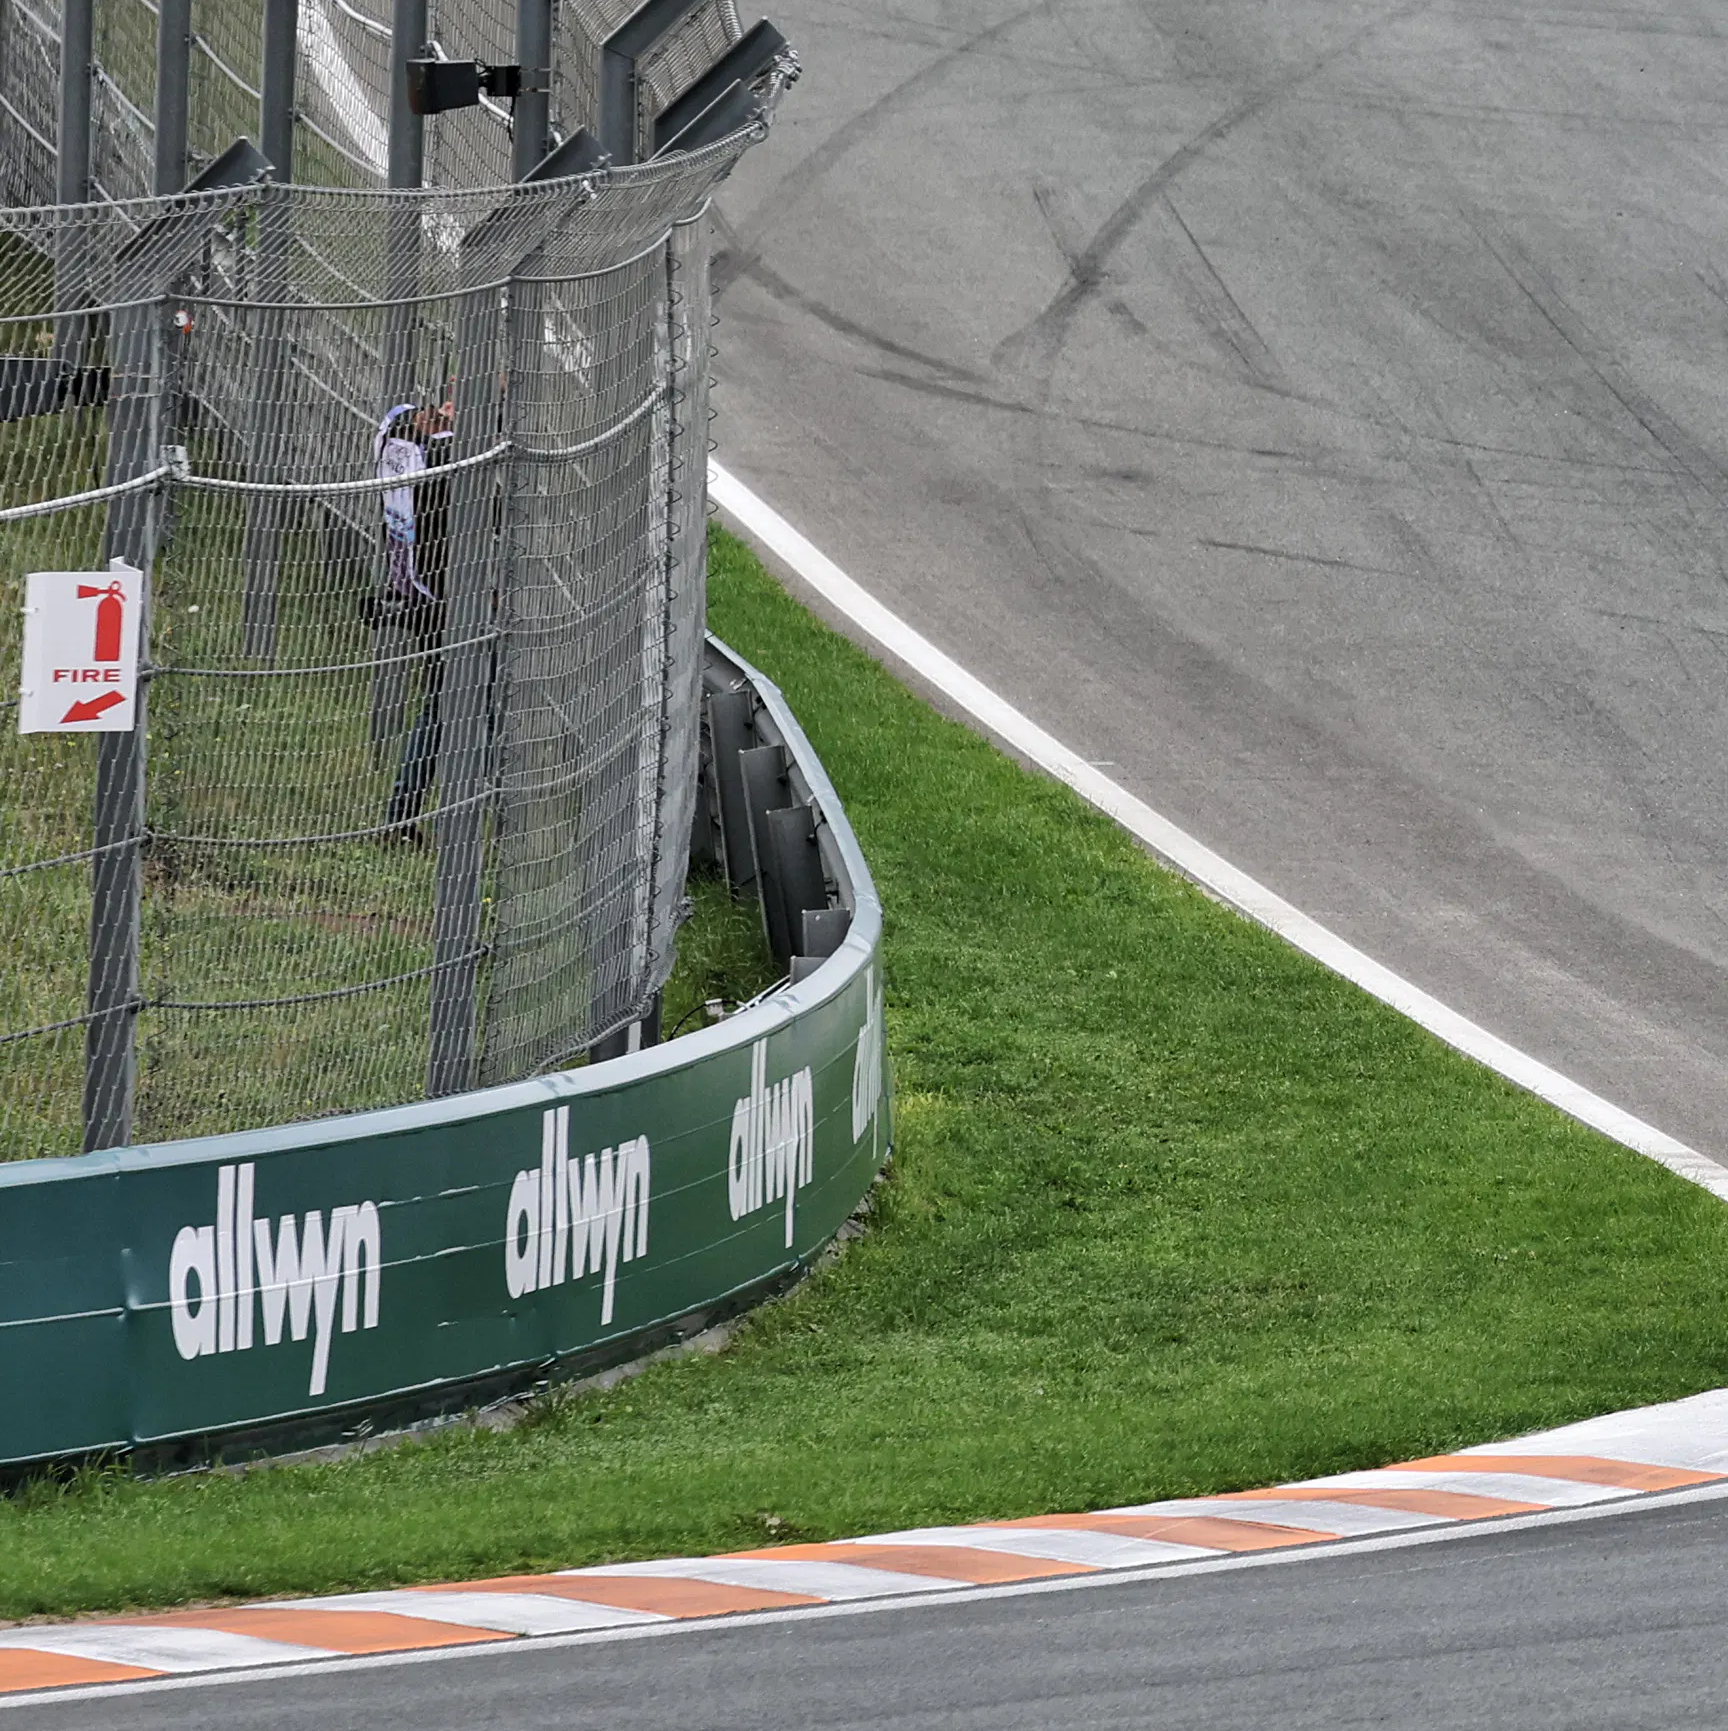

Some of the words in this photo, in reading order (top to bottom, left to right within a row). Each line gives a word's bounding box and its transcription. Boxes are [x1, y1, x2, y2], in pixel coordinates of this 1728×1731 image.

[53, 667, 122, 684] FIRE
[507, 1106, 649, 1325] allwyn
[729, 1042, 813, 1248] allwyn
[170, 1162, 382, 1396] allwyn
